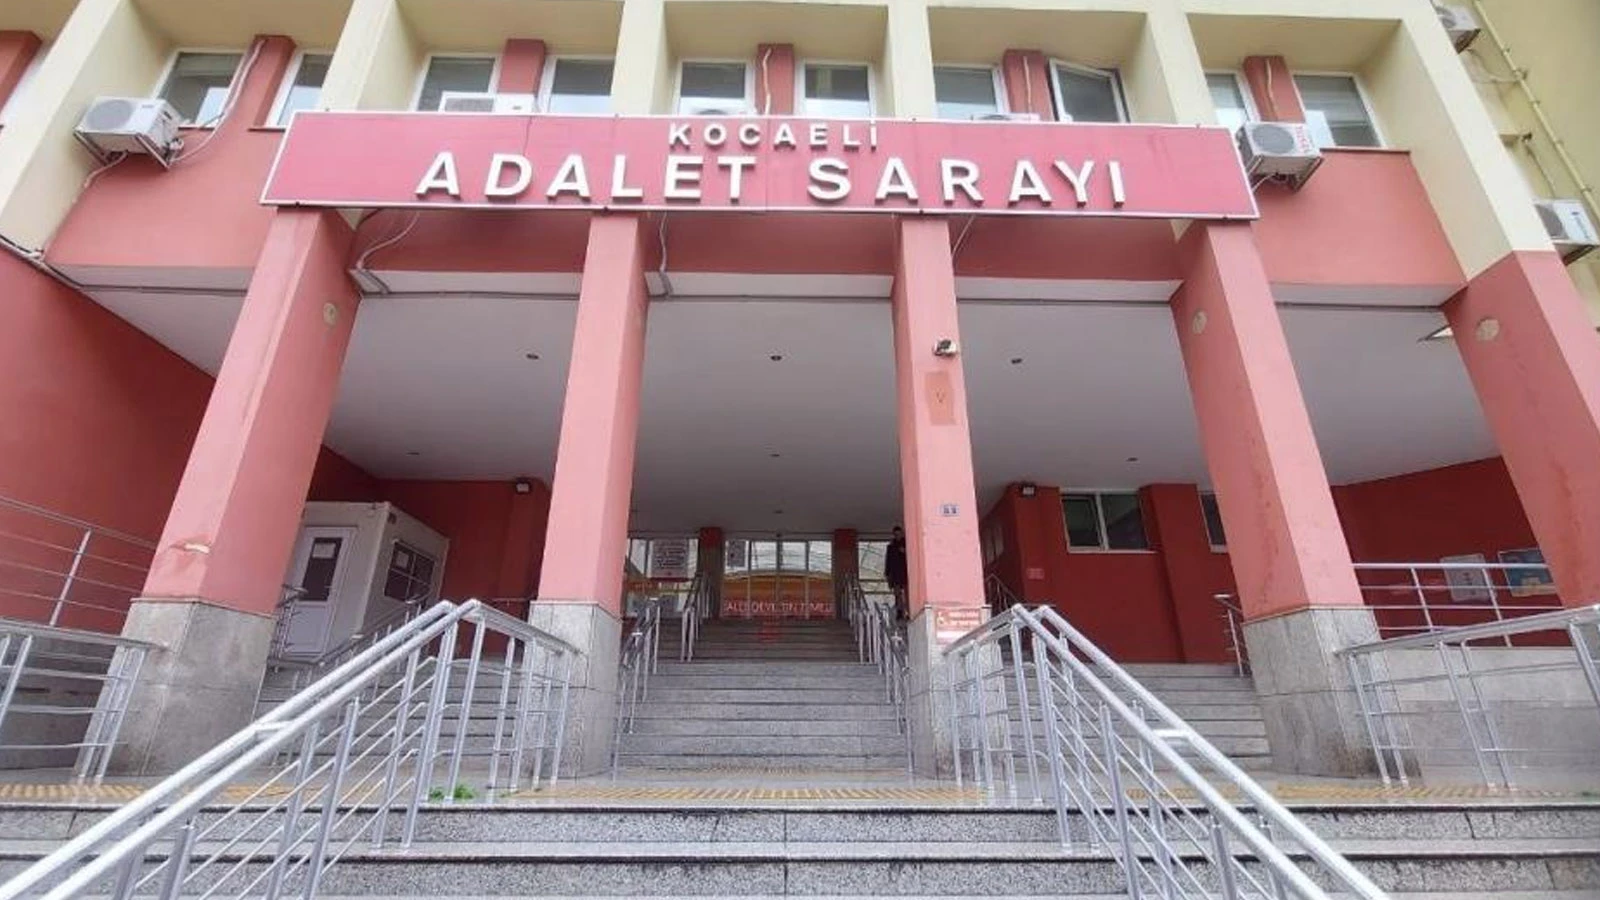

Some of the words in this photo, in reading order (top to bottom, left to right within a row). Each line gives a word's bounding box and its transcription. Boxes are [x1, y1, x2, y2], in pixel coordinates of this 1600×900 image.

[668, 118, 878, 150] KOCAELİ
[415, 150, 757, 203] ADALET
[806, 156, 1128, 207] SARAYI
